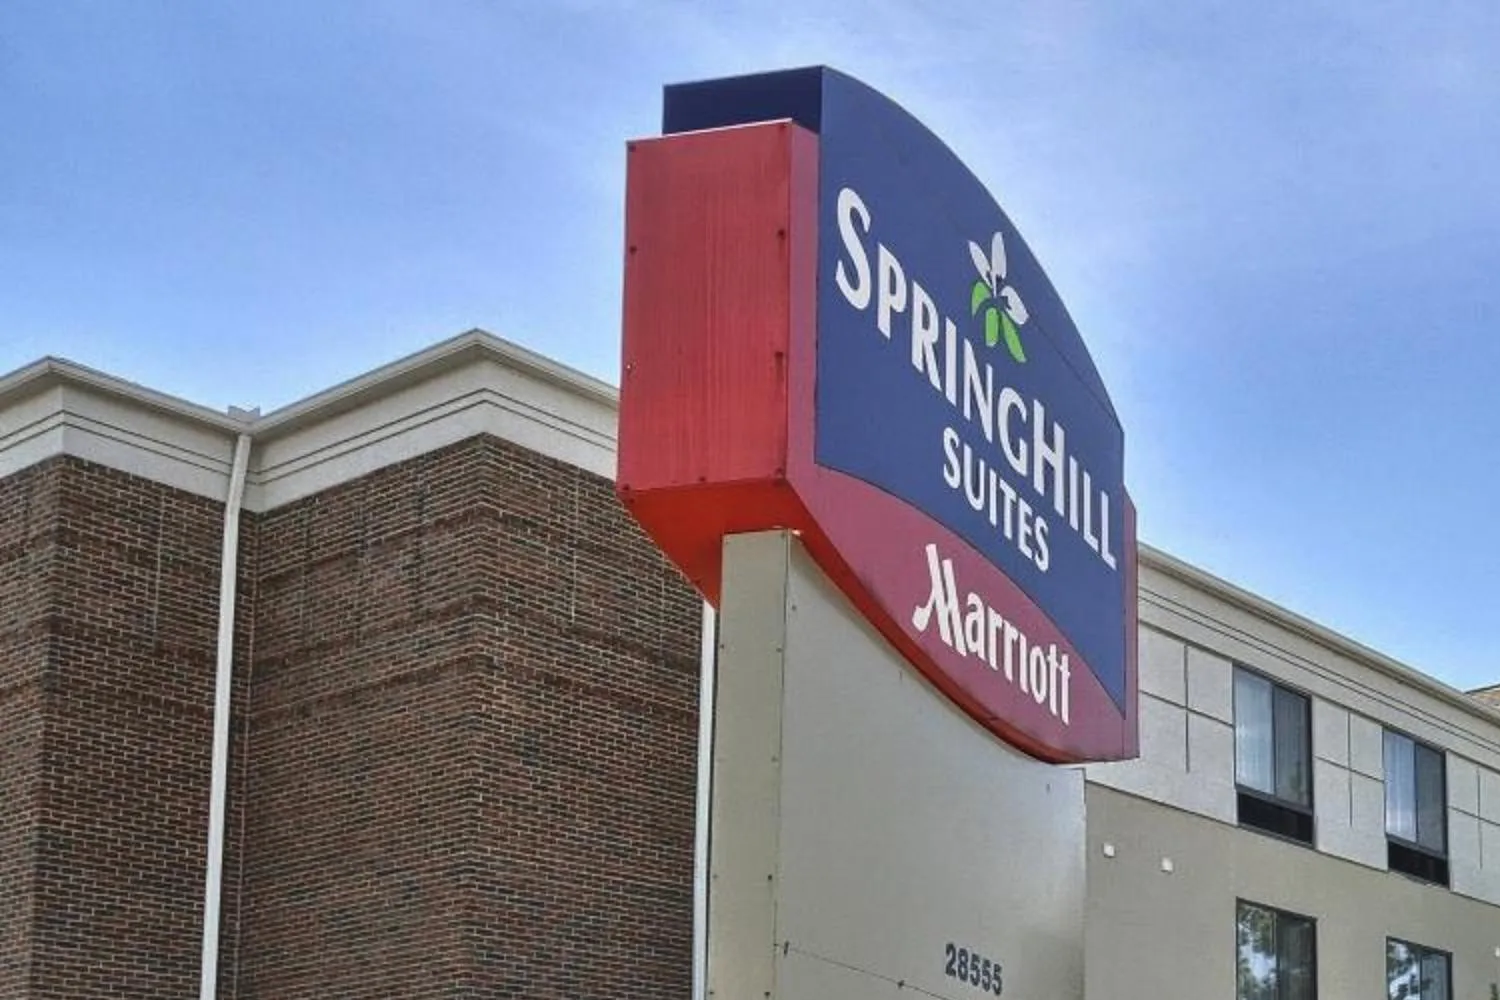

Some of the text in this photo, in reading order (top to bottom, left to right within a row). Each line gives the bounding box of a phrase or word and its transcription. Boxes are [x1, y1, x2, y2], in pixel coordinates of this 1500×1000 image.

[943, 427, 1050, 573] SUITES
[912, 543, 1072, 725] Marriott
[945, 943, 1003, 996] 28555
